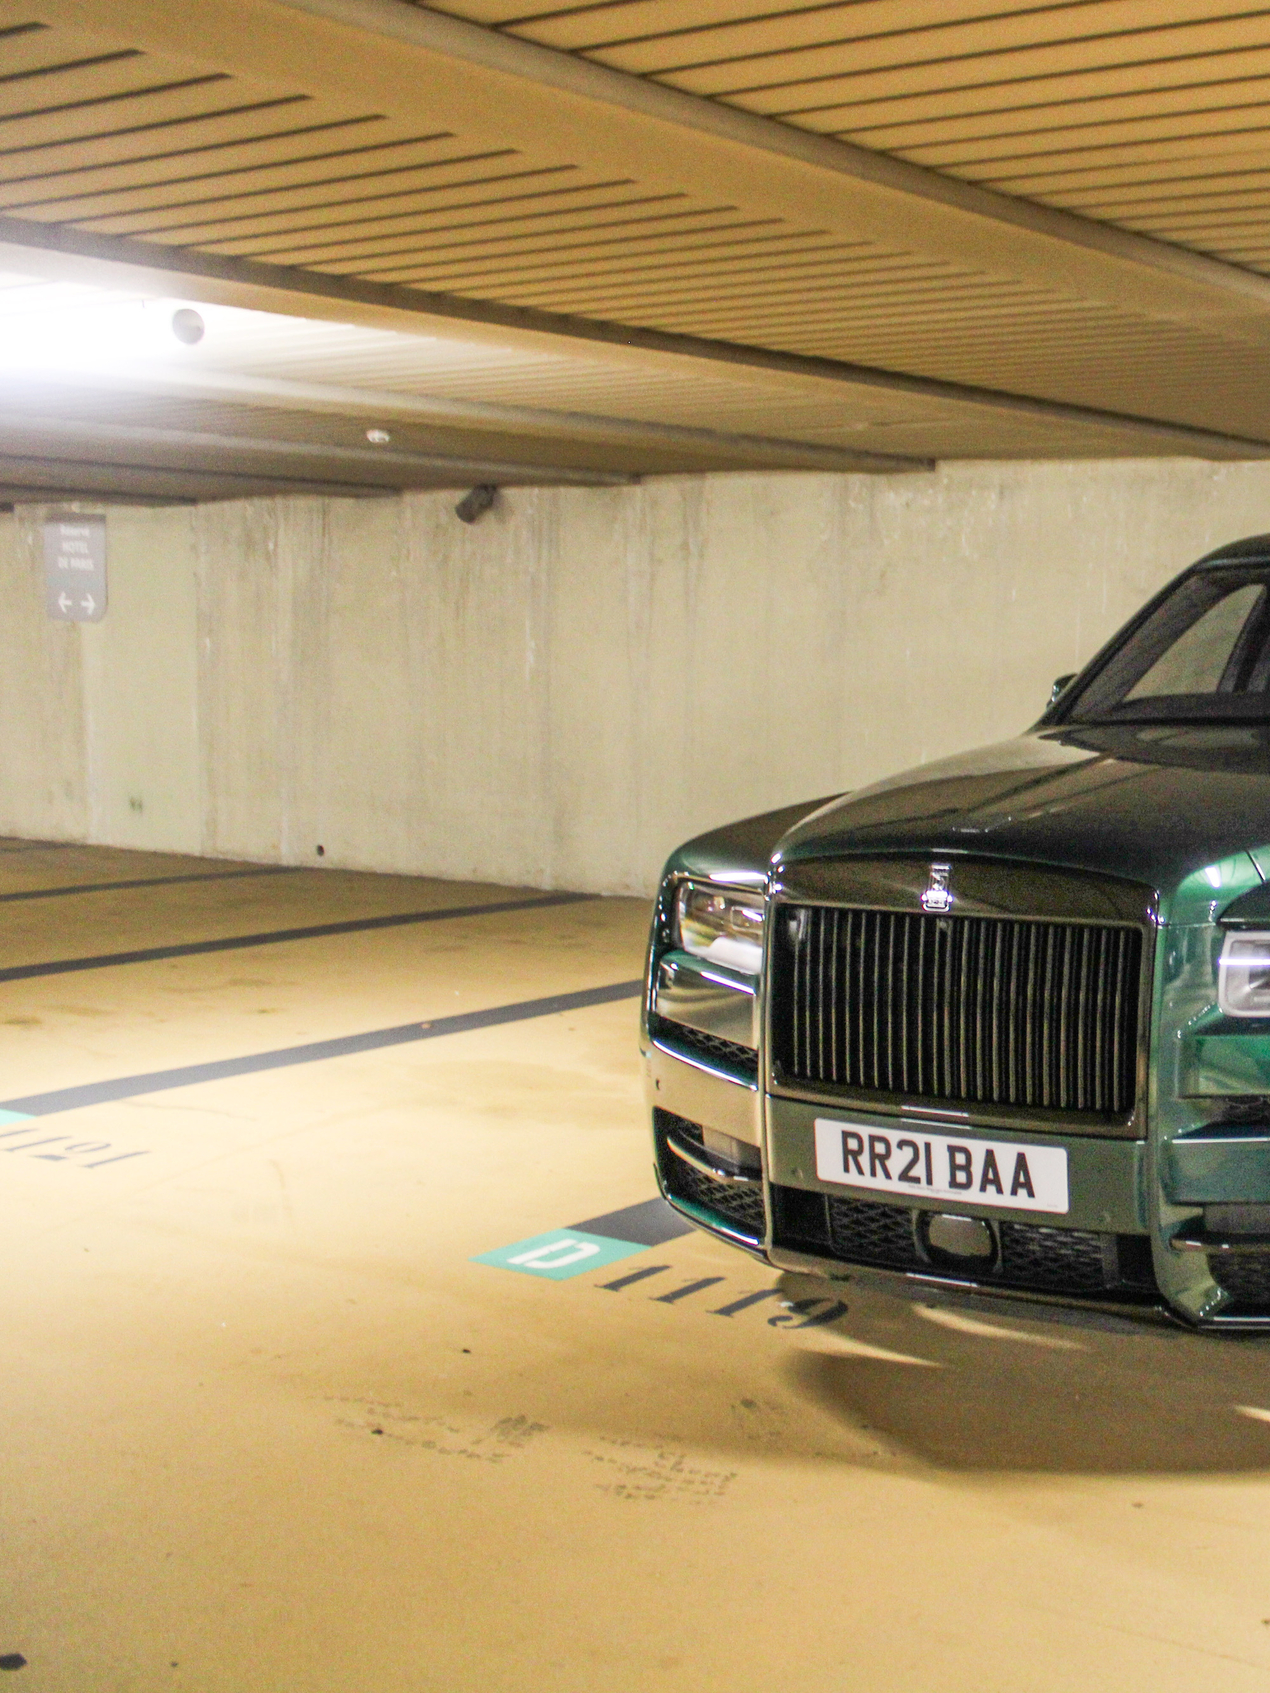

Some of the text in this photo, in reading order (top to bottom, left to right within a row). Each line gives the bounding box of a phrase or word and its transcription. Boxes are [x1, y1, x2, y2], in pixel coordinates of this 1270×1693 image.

[841, 1130, 1036, 1199] RR21 BAA
[506, 1238, 849, 1330] D 1119
